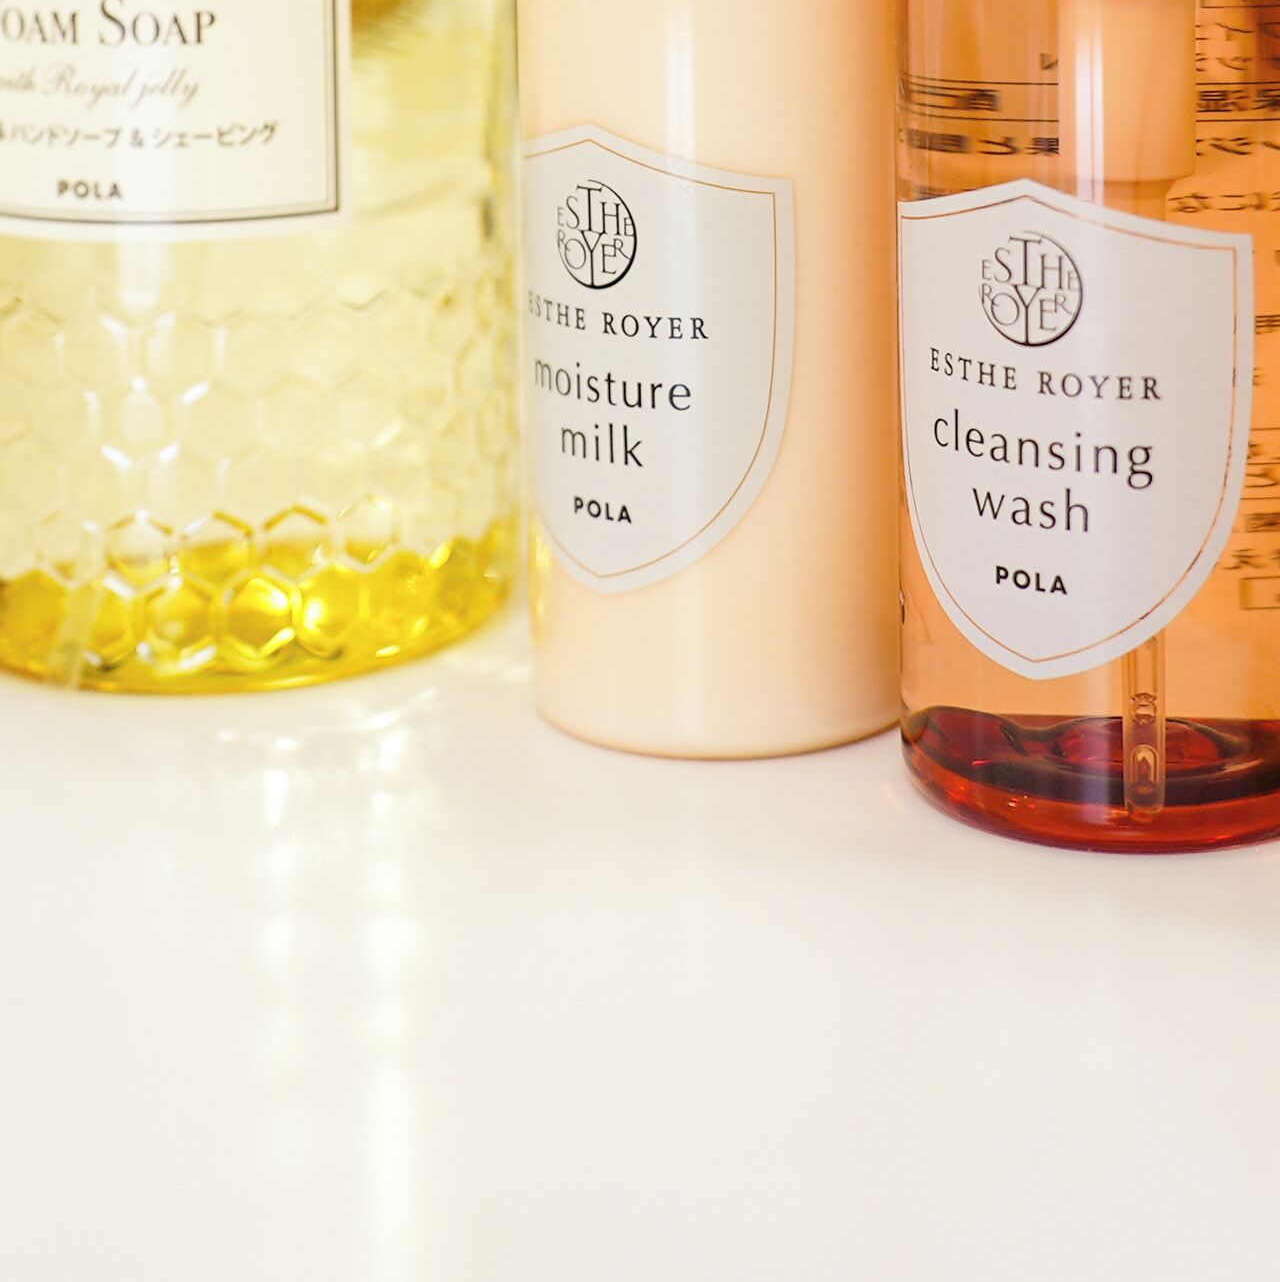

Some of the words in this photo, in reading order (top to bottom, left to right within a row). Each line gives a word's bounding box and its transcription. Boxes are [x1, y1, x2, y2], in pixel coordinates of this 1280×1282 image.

[42, 64, 138, 110] Royal
[128, 68, 199, 110] jelly
[57, 178, 122, 200] POLA
[528, 289, 587, 331] ESTHE
[601, 311, 709, 340] ROYER
[534, 359, 692, 412] moisture
[930, 347, 1018, 390] ESTHE
[1037, 370, 1162, 401] ROYER
[561, 423, 644, 468] milk
[933, 408, 1154, 489] cleansing
[573, 496, 633, 524] POLA
[972, 488, 1089, 533] wash
[995, 565, 1068, 595] POLA
